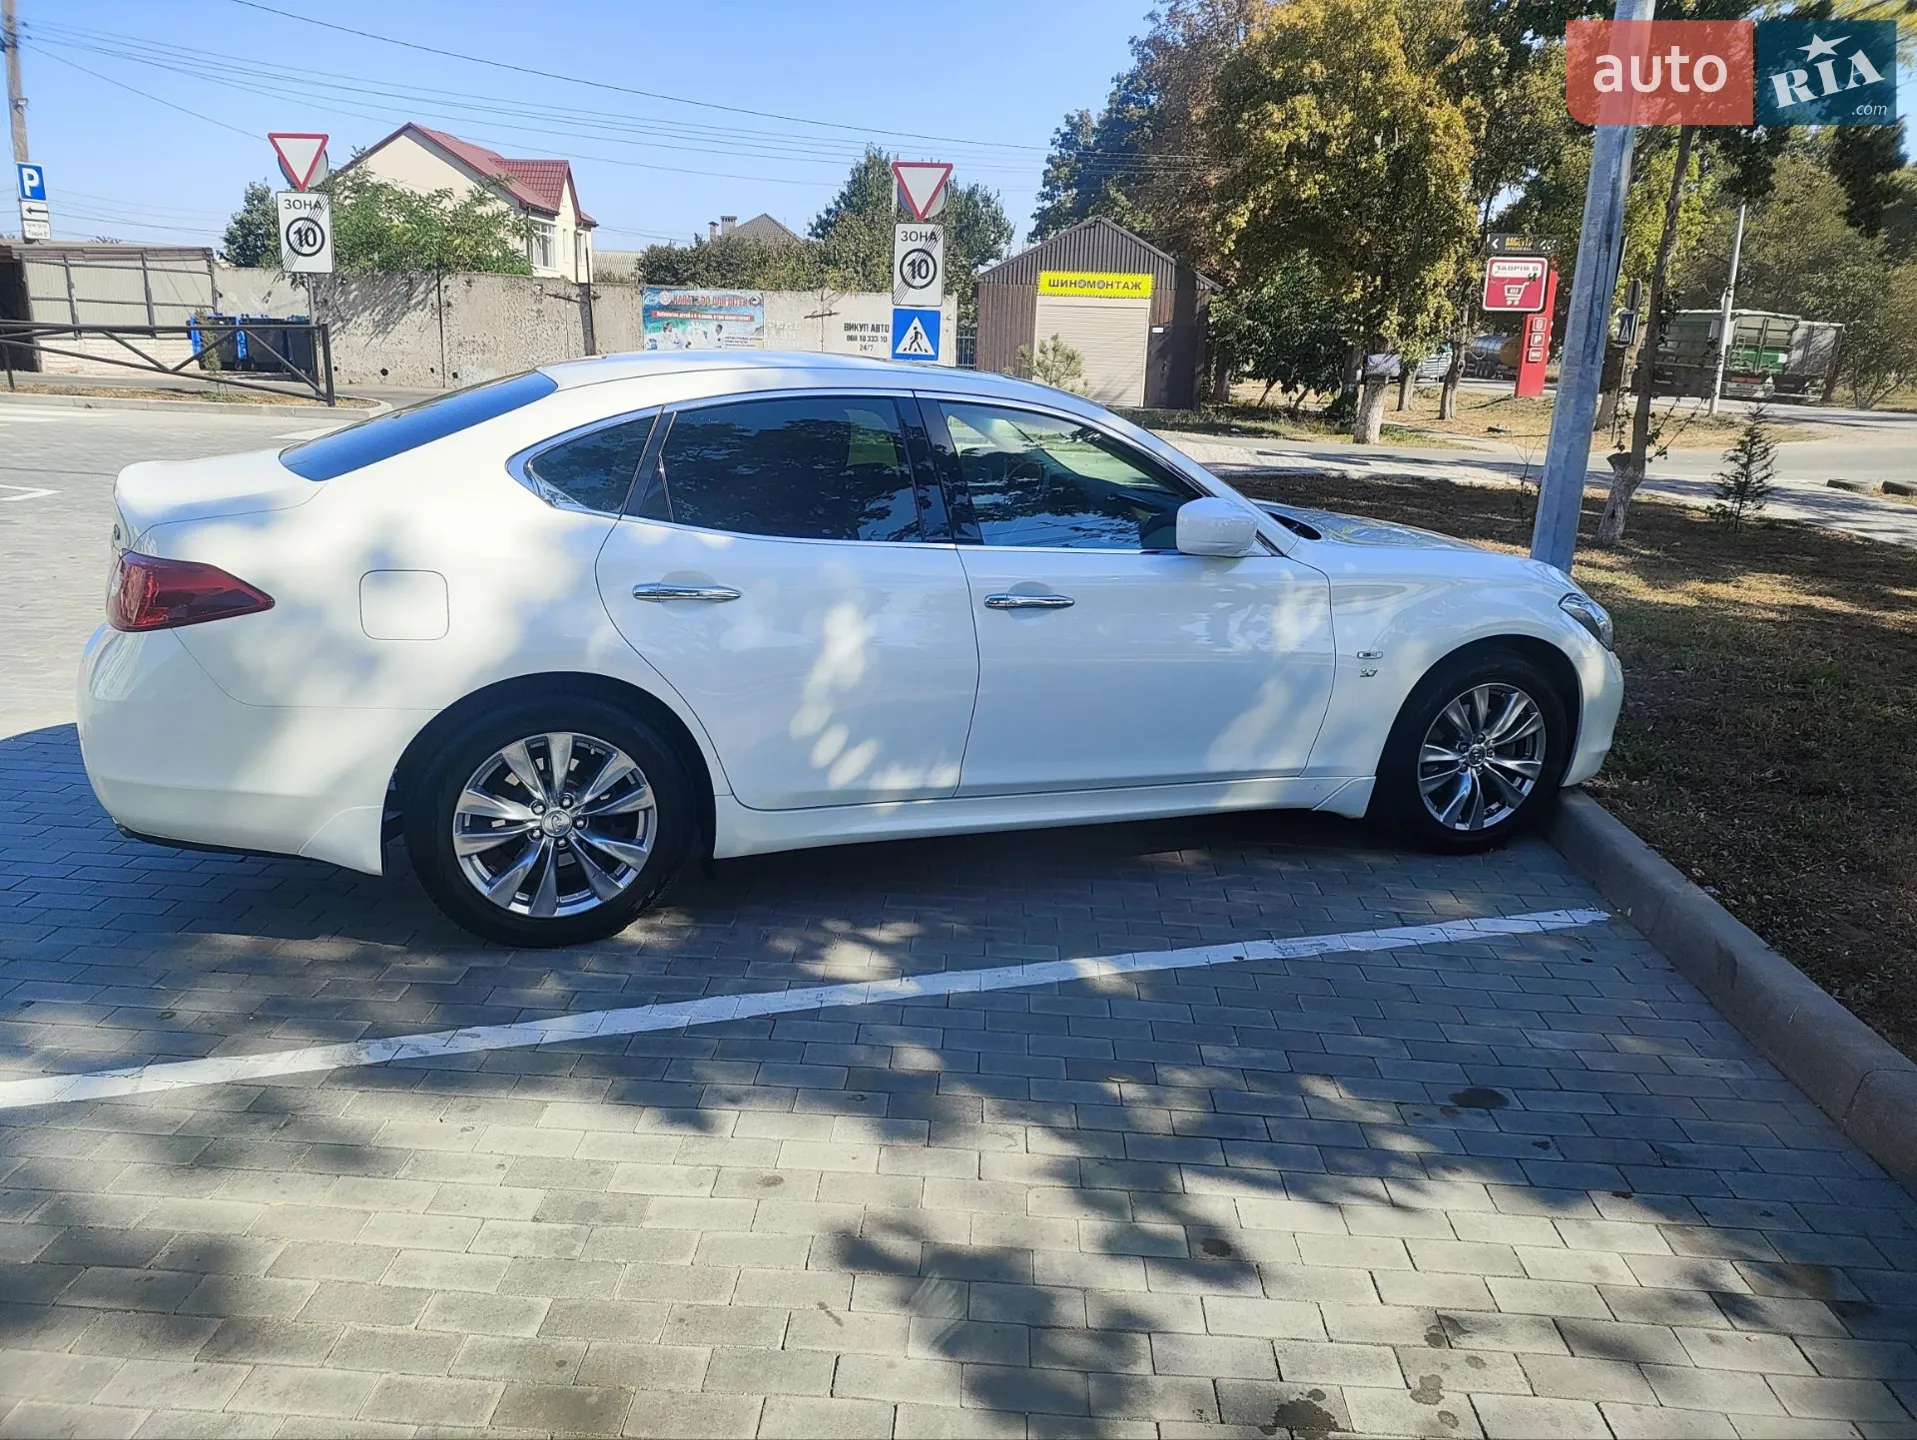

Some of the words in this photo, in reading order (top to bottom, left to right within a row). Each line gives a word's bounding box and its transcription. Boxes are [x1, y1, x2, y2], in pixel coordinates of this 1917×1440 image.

[22, 168, 40, 197] P
[284, 198, 323, 211] ЗОНА
[293, 227, 317, 248] 10
[900, 231, 938, 242] ЗОНА
[907, 259, 929, 279] 10
[1048, 278, 1142, 290] ШИНОМОНТАЖ
[844, 322, 869, 332] ВИКУП
[870, 323, 890, 333] АВТО
